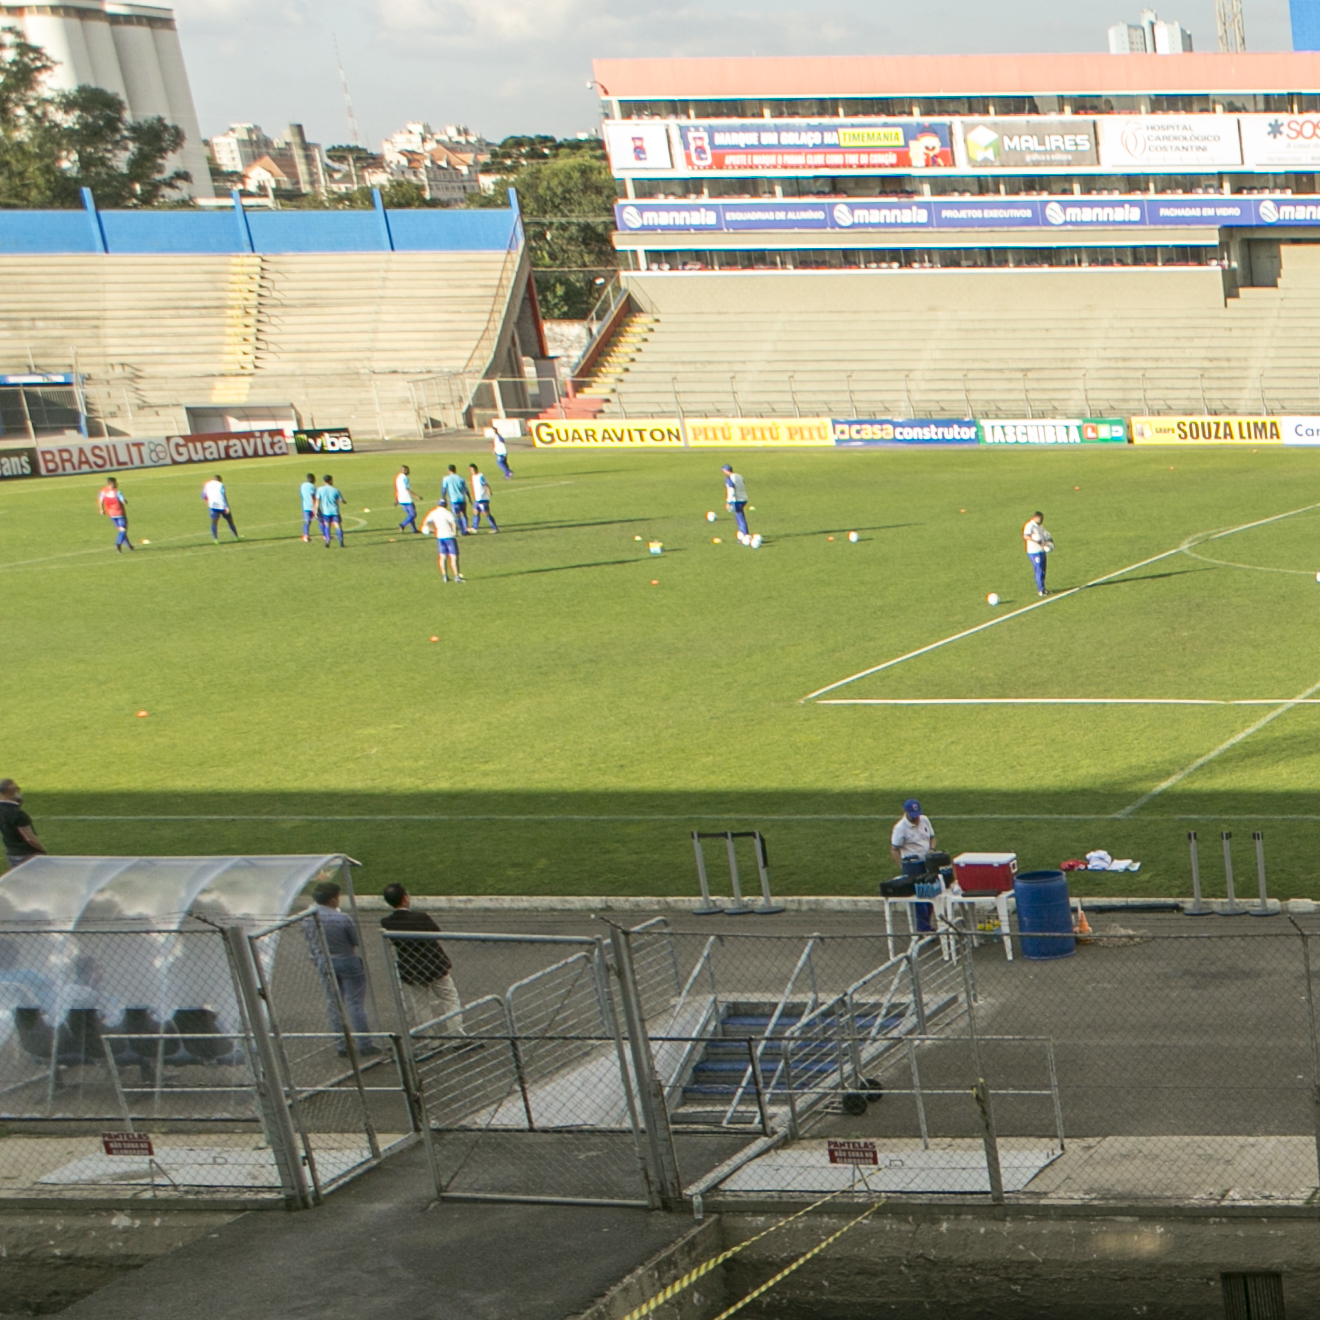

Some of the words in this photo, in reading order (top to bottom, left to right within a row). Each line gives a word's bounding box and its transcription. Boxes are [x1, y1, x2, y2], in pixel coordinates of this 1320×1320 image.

[714, 132, 759, 147] MARQUE
[760, 132, 778, 145] UM
[780, 131, 822, 147] GOLAÇO
[824, 131, 839, 145] NA
[843, 132, 900, 143] TIMEMANIA
[1003, 135, 1090, 151] MALIRES
[1148, 133, 1220, 142] CARDIOLÓGICO
[942, 209, 982, 218] PROJETOS
[1160, 208, 1201, 216] FACHADAS
[1202, 208, 1215, 216] EM
[1216, 208, 1240, 216] VIDRO
[536, 423, 681, 445] GUARAVITON
[692, 422, 732, 441] PITÚ
[741, 422, 780, 440] PITÚ
[789, 422, 828, 440] PITÚ
[851, 425, 893, 439] casa
[895, 424, 977, 440] construtor
[980, 420, 1082, 443] TASCHIBRA
[1177, 421, 1234, 440] SOUZA
[1238, 421, 1280, 439] LIMA
[170, 431, 287, 465] Guaravita
[42, 442, 145, 473] BRASILIT
[828, 1140, 875, 1149] PANTELAS
